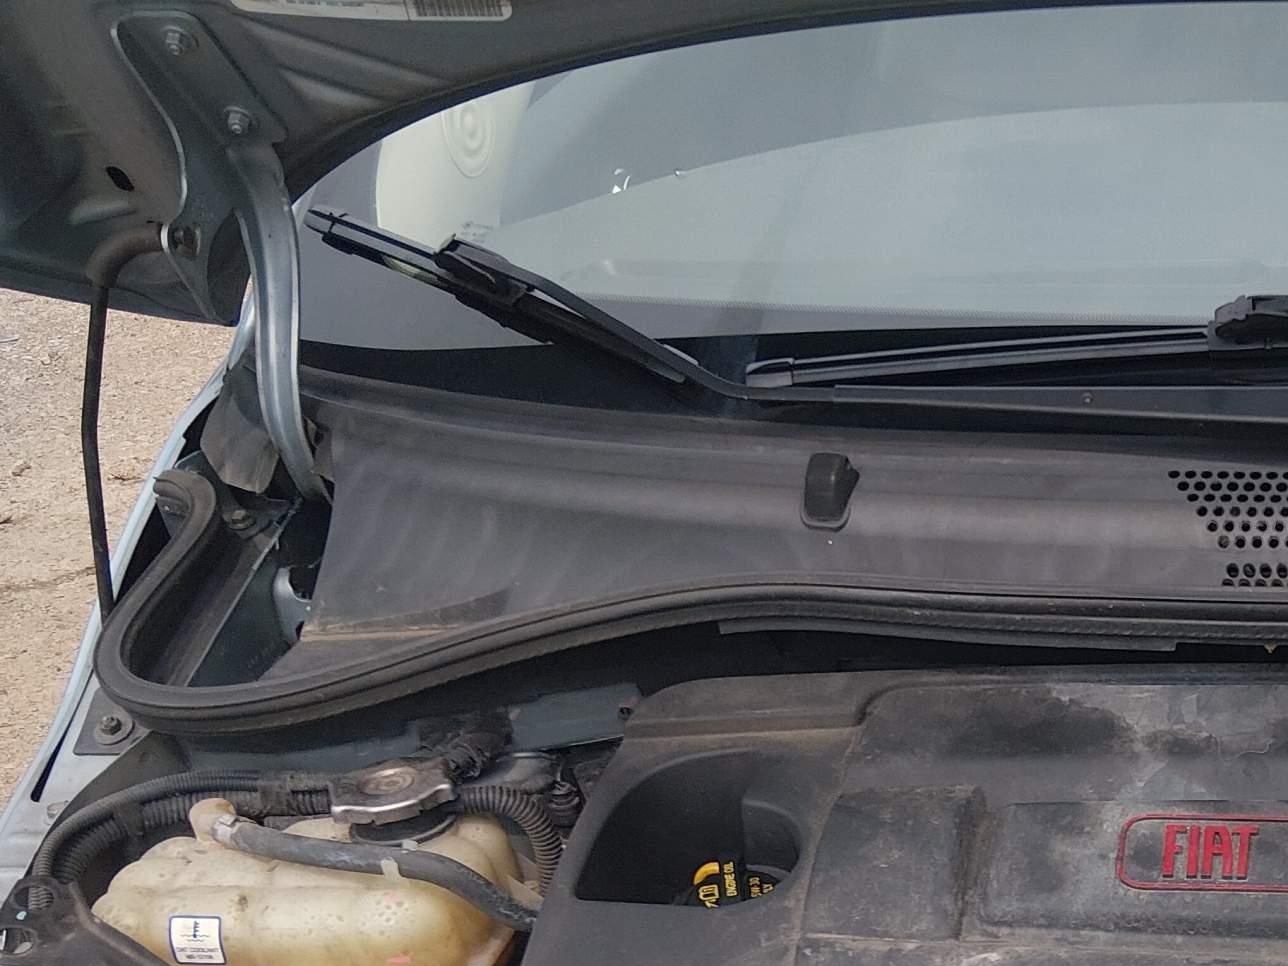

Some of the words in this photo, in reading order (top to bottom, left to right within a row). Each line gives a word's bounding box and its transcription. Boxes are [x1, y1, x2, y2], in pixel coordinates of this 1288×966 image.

[1161, 824, 1260, 881] FIAT
[723, 862, 734, 873] OIL
[724, 873, 737, 897] ENGINE
